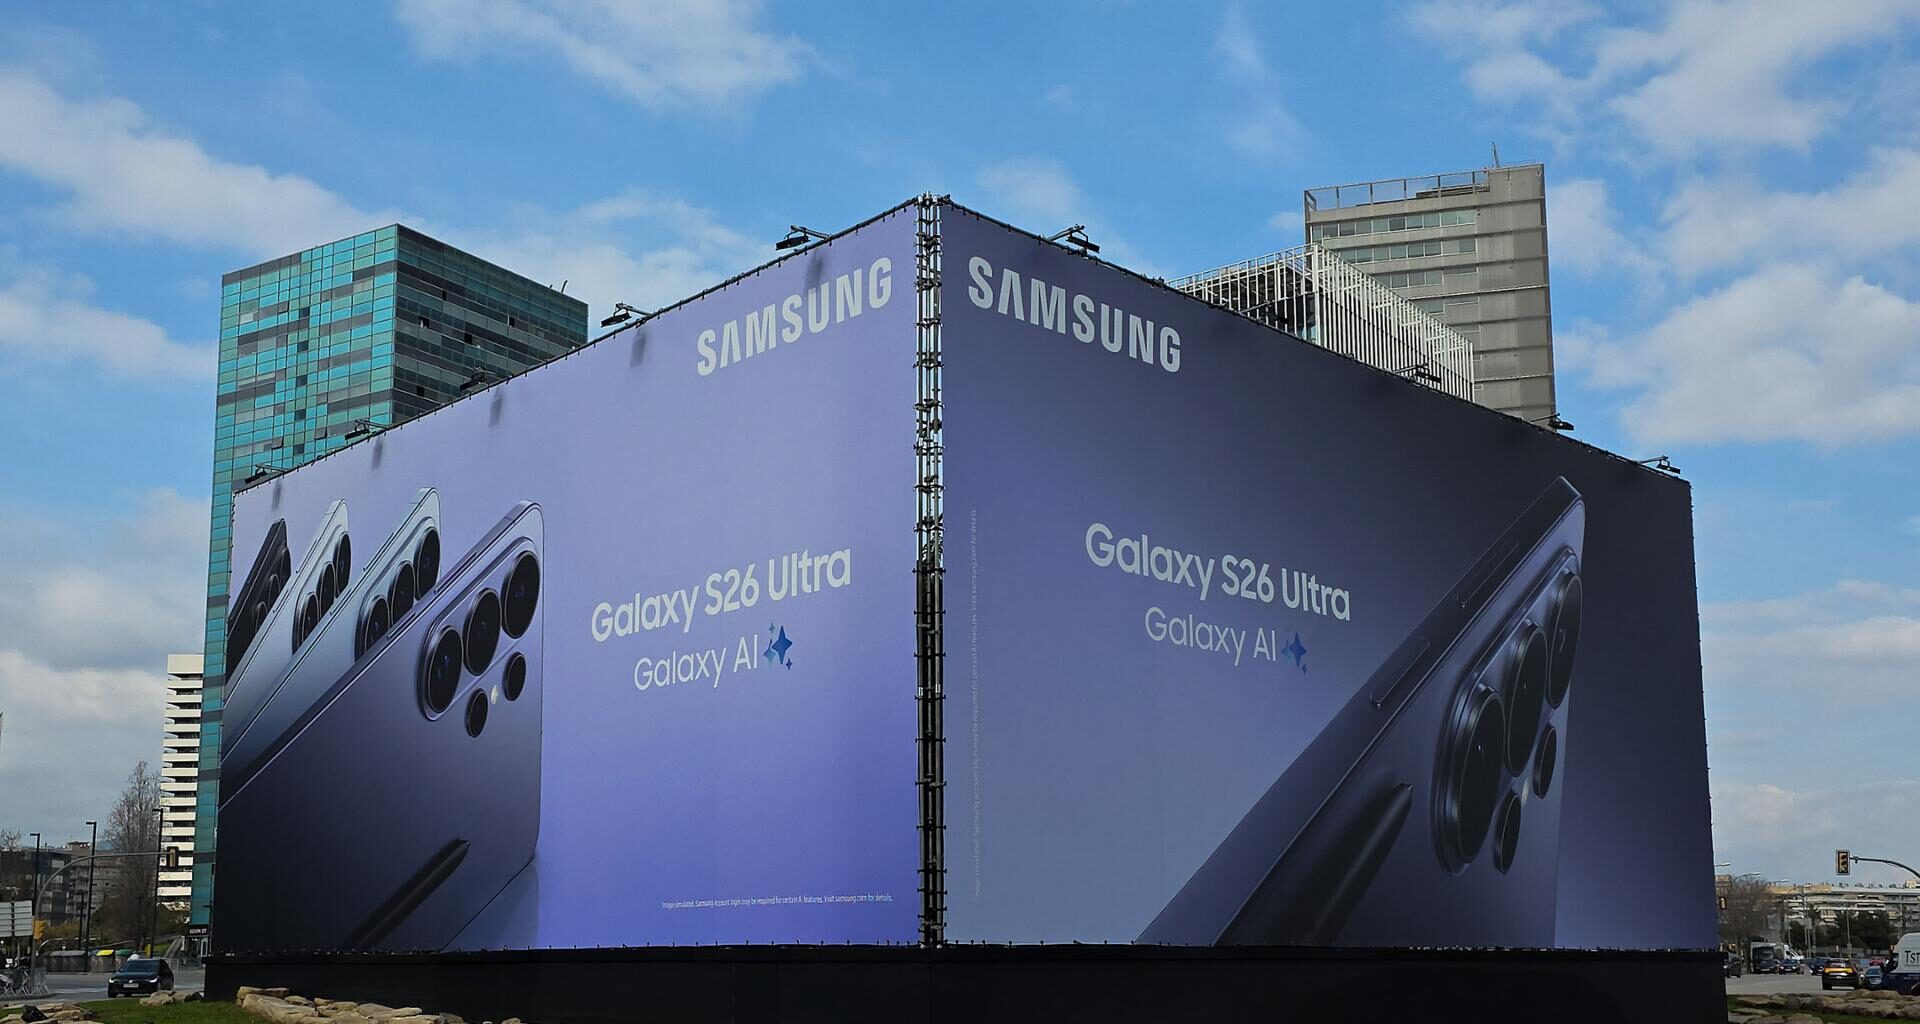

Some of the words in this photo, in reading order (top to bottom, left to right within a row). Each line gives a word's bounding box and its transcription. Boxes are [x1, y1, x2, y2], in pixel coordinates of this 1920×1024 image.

[697, 257, 892, 376] SAMSUNG
[968, 256, 1181, 373] SAMSUNG
[591, 585, 699, 642] Galaxy
[704, 563, 759, 615] S26
[768, 548, 851, 601] Ultra
[1085, 523, 1215, 601] Galaxy
[1221, 554, 1275, 603] S26
[1281, 567, 1350, 621] Ultra
[634, 647, 727, 691] Galaxy
[733, 634, 758, 673] AI
[1145, 606, 1246, 666] Galaxy
[1253, 627, 1276, 661] AI
